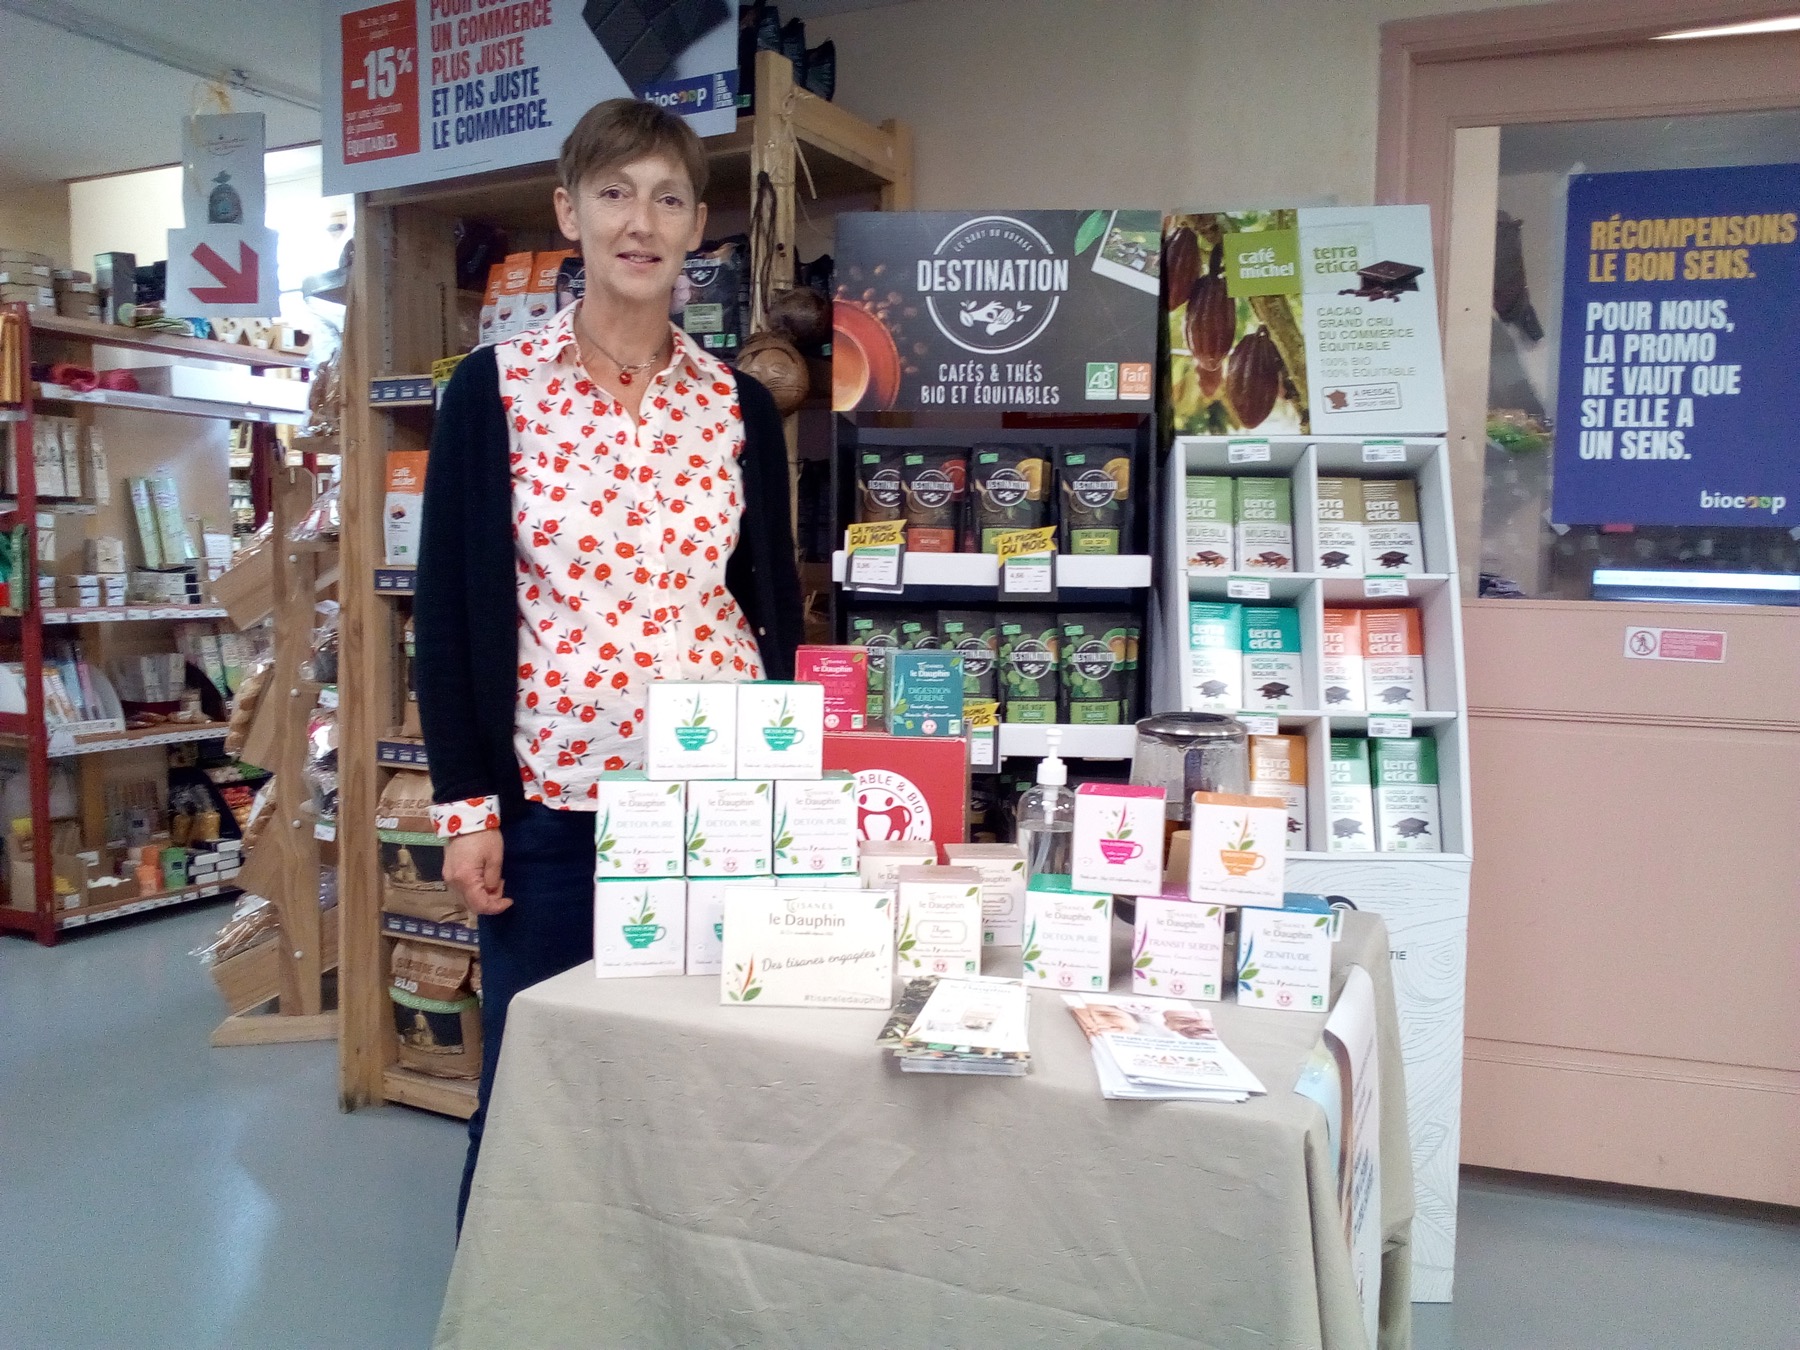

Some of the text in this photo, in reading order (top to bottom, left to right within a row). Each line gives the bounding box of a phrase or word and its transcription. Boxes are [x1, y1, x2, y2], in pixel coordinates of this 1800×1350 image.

[431, 0, 552, 52] UN COMMERCE
[432, 36, 524, 85] PLUS JUSTE
[351, 46, 413, 100] -15%
[432, 66, 539, 117] ET PAS JUSTE
[432, 98, 553, 150] LE COMMERCE.
[1590, 213, 1798, 250] RÉCOMPENSONS
[1239, 247, 1275, 264] café
[1313, 246, 1358, 260] terra
[1240, 262, 1294, 279] michel
[1315, 259, 1358, 274] etica
[1589, 249, 1757, 282] LE BON SENS.
[917, 259, 1069, 292] DESTINATION
[1317, 307, 1363, 316] CACAO
[1586, 300, 1735, 333] POUR NOUS,
[1318, 317, 1394, 328] GRAND CRU
[1319, 328, 1414, 340] DU COMMERCE
[1584, 333, 1717, 363] LA PROMO
[1351, 356, 1372, 366] BIO
[939, 360, 1043, 383] CAFÉS & THÉS
[1122, 367, 1148, 383] fair
[1583, 365, 1742, 397] NE VAUT QUE
[921, 382, 1060, 405] BIO ET ÉQUITABLES
[1580, 398, 1695, 427] SI ELLE A
[1579, 431, 1692, 459] UN SENS.
[864, 524, 893, 534] PROMO
[1014, 531, 1043, 541] PROMO
[851, 532, 897, 545] DU MOIS
[1001, 538, 1049, 555] DU MOIS
[618, 799, 667, 808] le Dauphin
[708, 798, 755, 808] le Dauphin
[805, 797, 841, 806] Dauphin
[896, 781, 906, 792] &
[907, 792, 925, 815] BIO
[616, 821, 649, 829] DETOX
[706, 819, 761, 827] DETOX PURE
[794, 818, 848, 826] DETOX PURE
[928, 902, 965, 910] Dauphin
[769, 913, 846, 929] le Dauphin
[1045, 911, 1092, 922] le Dauphin
[1166, 919, 1205, 930] Dauphin
[1042, 932, 1099, 943] DETOX PURE
[1263, 928, 1312, 940] le Dauphin
[1149, 938, 1219, 951] TRANSIT SEREIN
[762, 958, 783, 972] Des
[786, 955, 825, 969] tisanes
[828, 949, 877, 966] engagées
[1264, 951, 1311, 962] ZENITUDE
